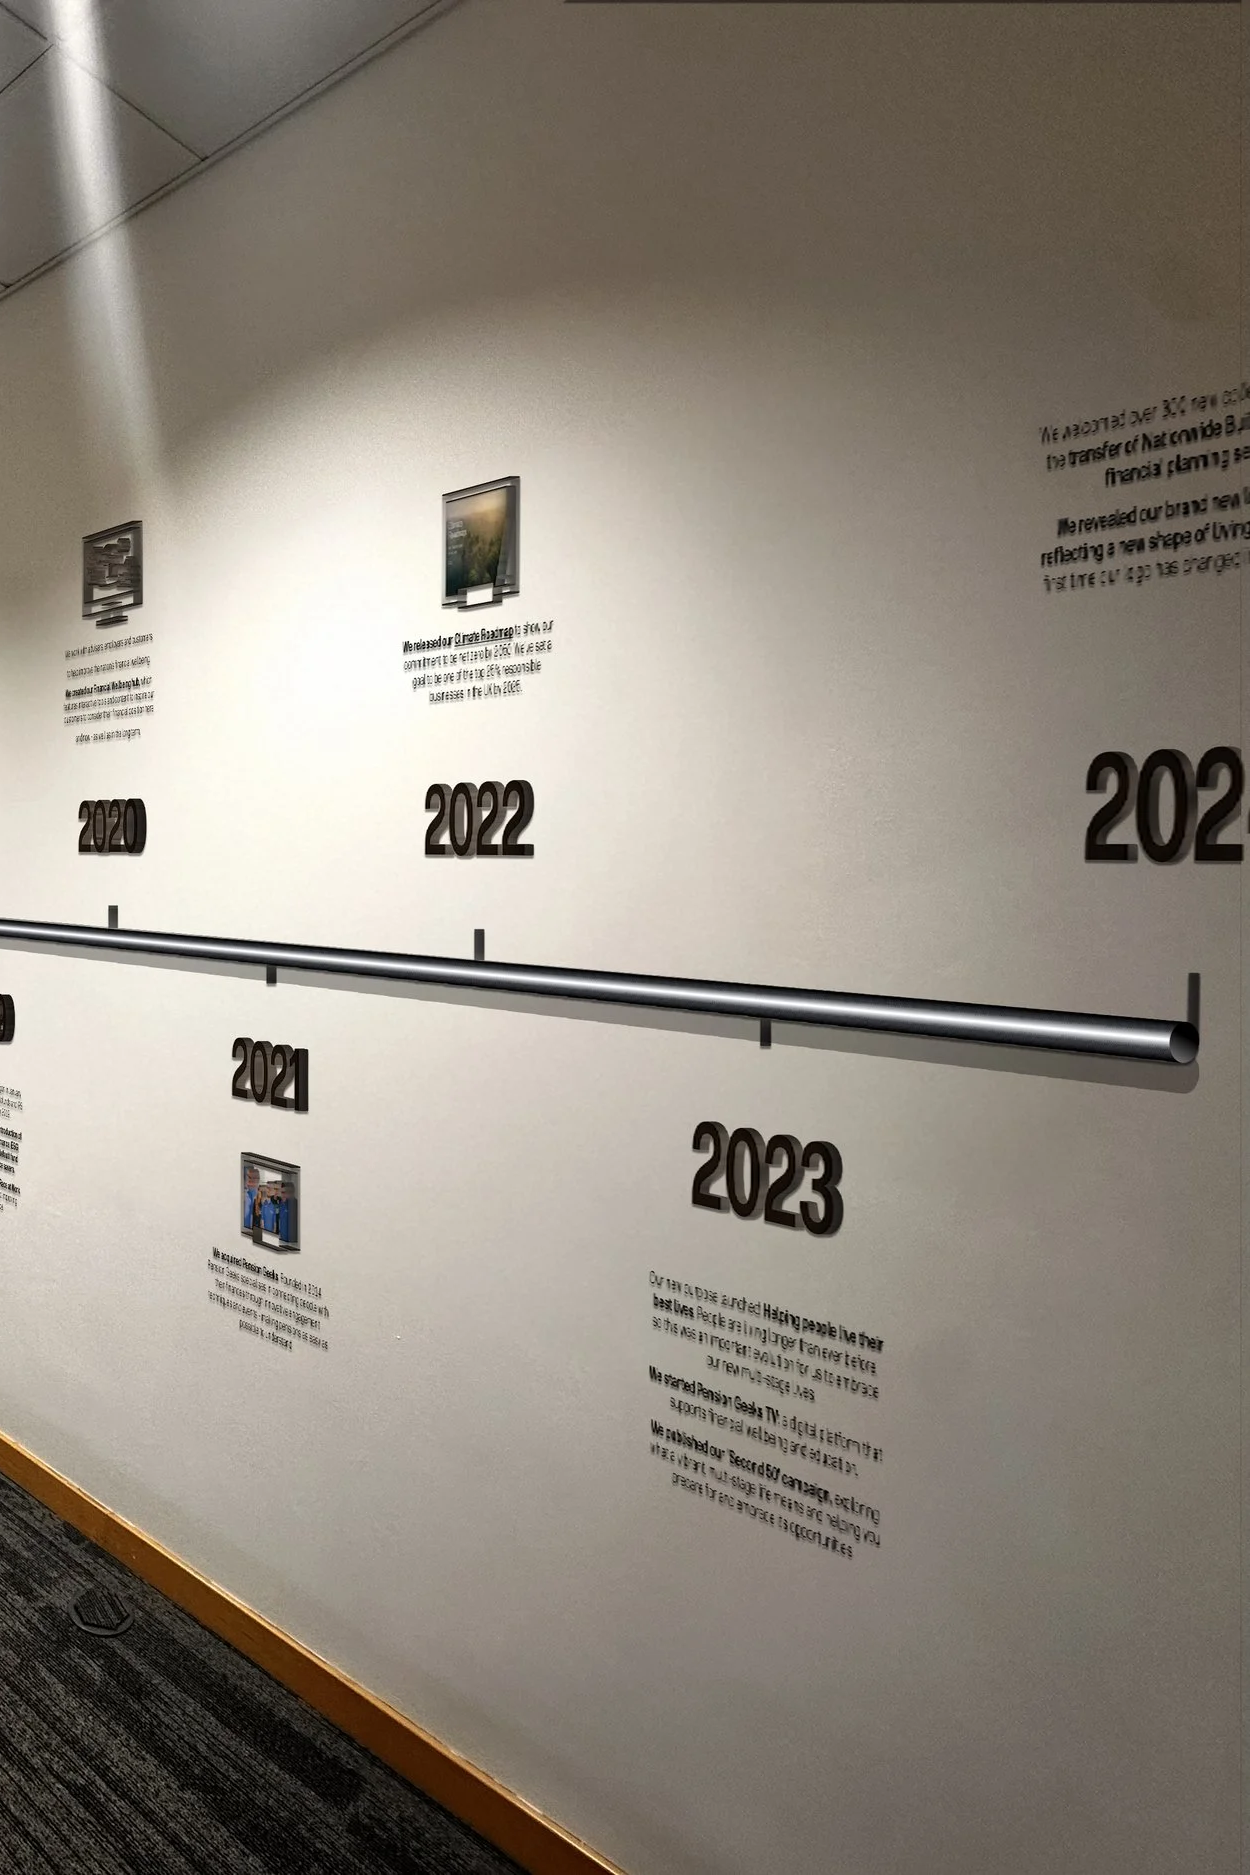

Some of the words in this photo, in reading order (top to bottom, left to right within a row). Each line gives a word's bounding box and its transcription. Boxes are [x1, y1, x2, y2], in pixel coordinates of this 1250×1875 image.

[1068, 440, 1121, 468] transfer
[1141, 418, 1222, 452] Nationwide
[1105, 460, 1162, 487] financial
[1078, 505, 1137, 535] revealed
[1165, 497, 1207, 520] brand
[1041, 542, 1104, 567] reflecting
[1119, 537, 1144, 555] new
[1148, 530, 1192, 553] shape
[413, 635, 441, 652] released
[453, 631, 479, 648] Climate
[480, 626, 513, 644] Roadmap
[78, 798, 146, 853] 2020
[425, 780, 534, 856] 2022
[1085, 746, 1250, 865] 202
[231, 1037, 308, 1112] 2021
[692, 1121, 843, 1236] 2023
[653, 1293, 672, 1312] best
[763, 1302, 800, 1334] Helping
[801, 1317, 836, 1339] people
[839, 1324, 855, 1346] live
[857, 1331, 883, 1353] their
[649, 1365, 662, 1385] We
[663, 1373, 695, 1397] started
[696, 1381, 732, 1408] Pension
[734, 1395, 763, 1421] Geeks
[650, 1419, 663, 1439] We
[665, 1428, 708, 1457] published
